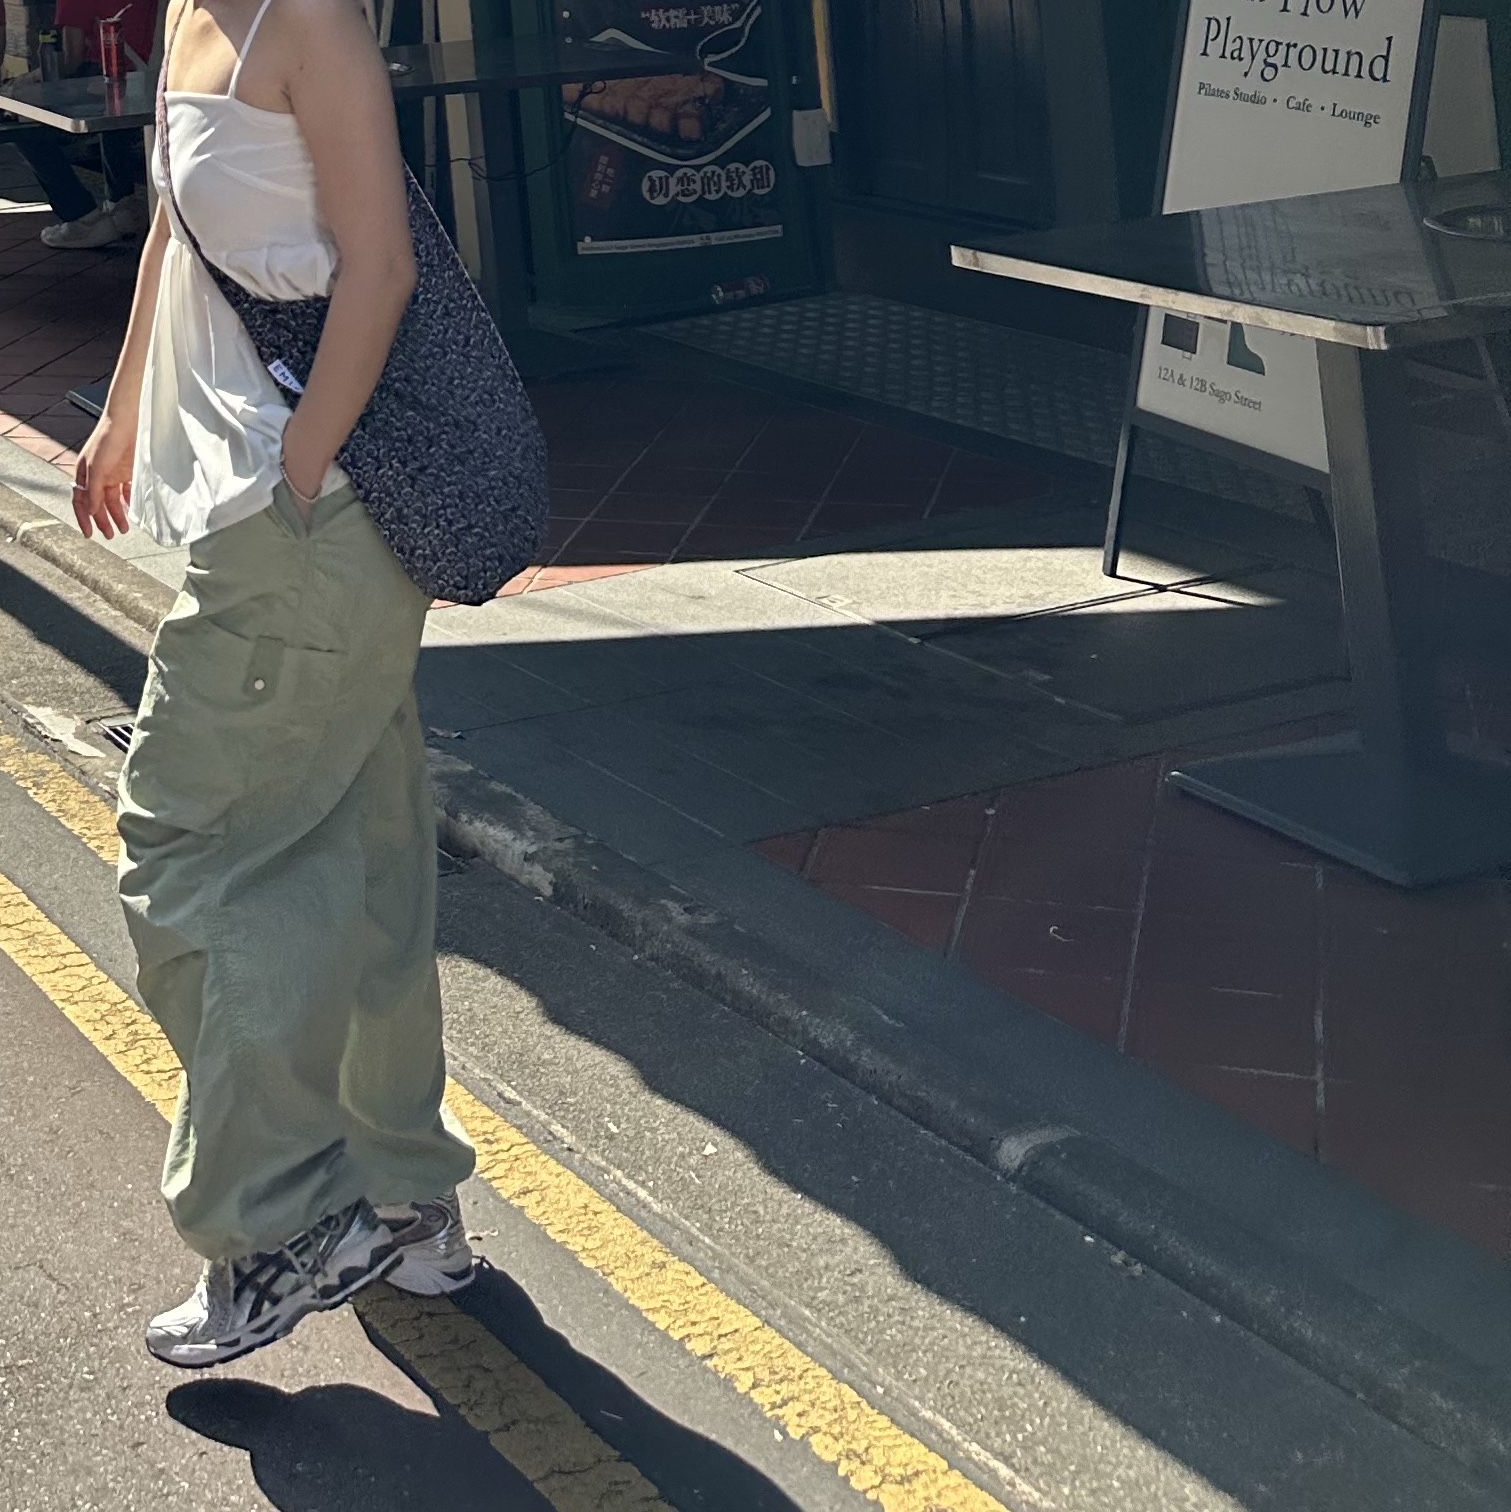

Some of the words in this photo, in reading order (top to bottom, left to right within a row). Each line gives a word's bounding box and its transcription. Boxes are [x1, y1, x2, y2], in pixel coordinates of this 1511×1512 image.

[1199, 15, 1394, 83] Playground
[1197, 81, 1230, 100] Pilates
[1232, 87, 1268, 106] Studio
[1286, 95, 1313, 113] Cafe
[1330, 102, 1381, 129] Lounge
[1157, 365, 1176, 384] 12A
[1177, 373, 1187, 388] &
[1189, 375, 1207, 394] 12B
[1209, 382, 1232, 405] Sago
[1233, 390, 1263, 411] Street
